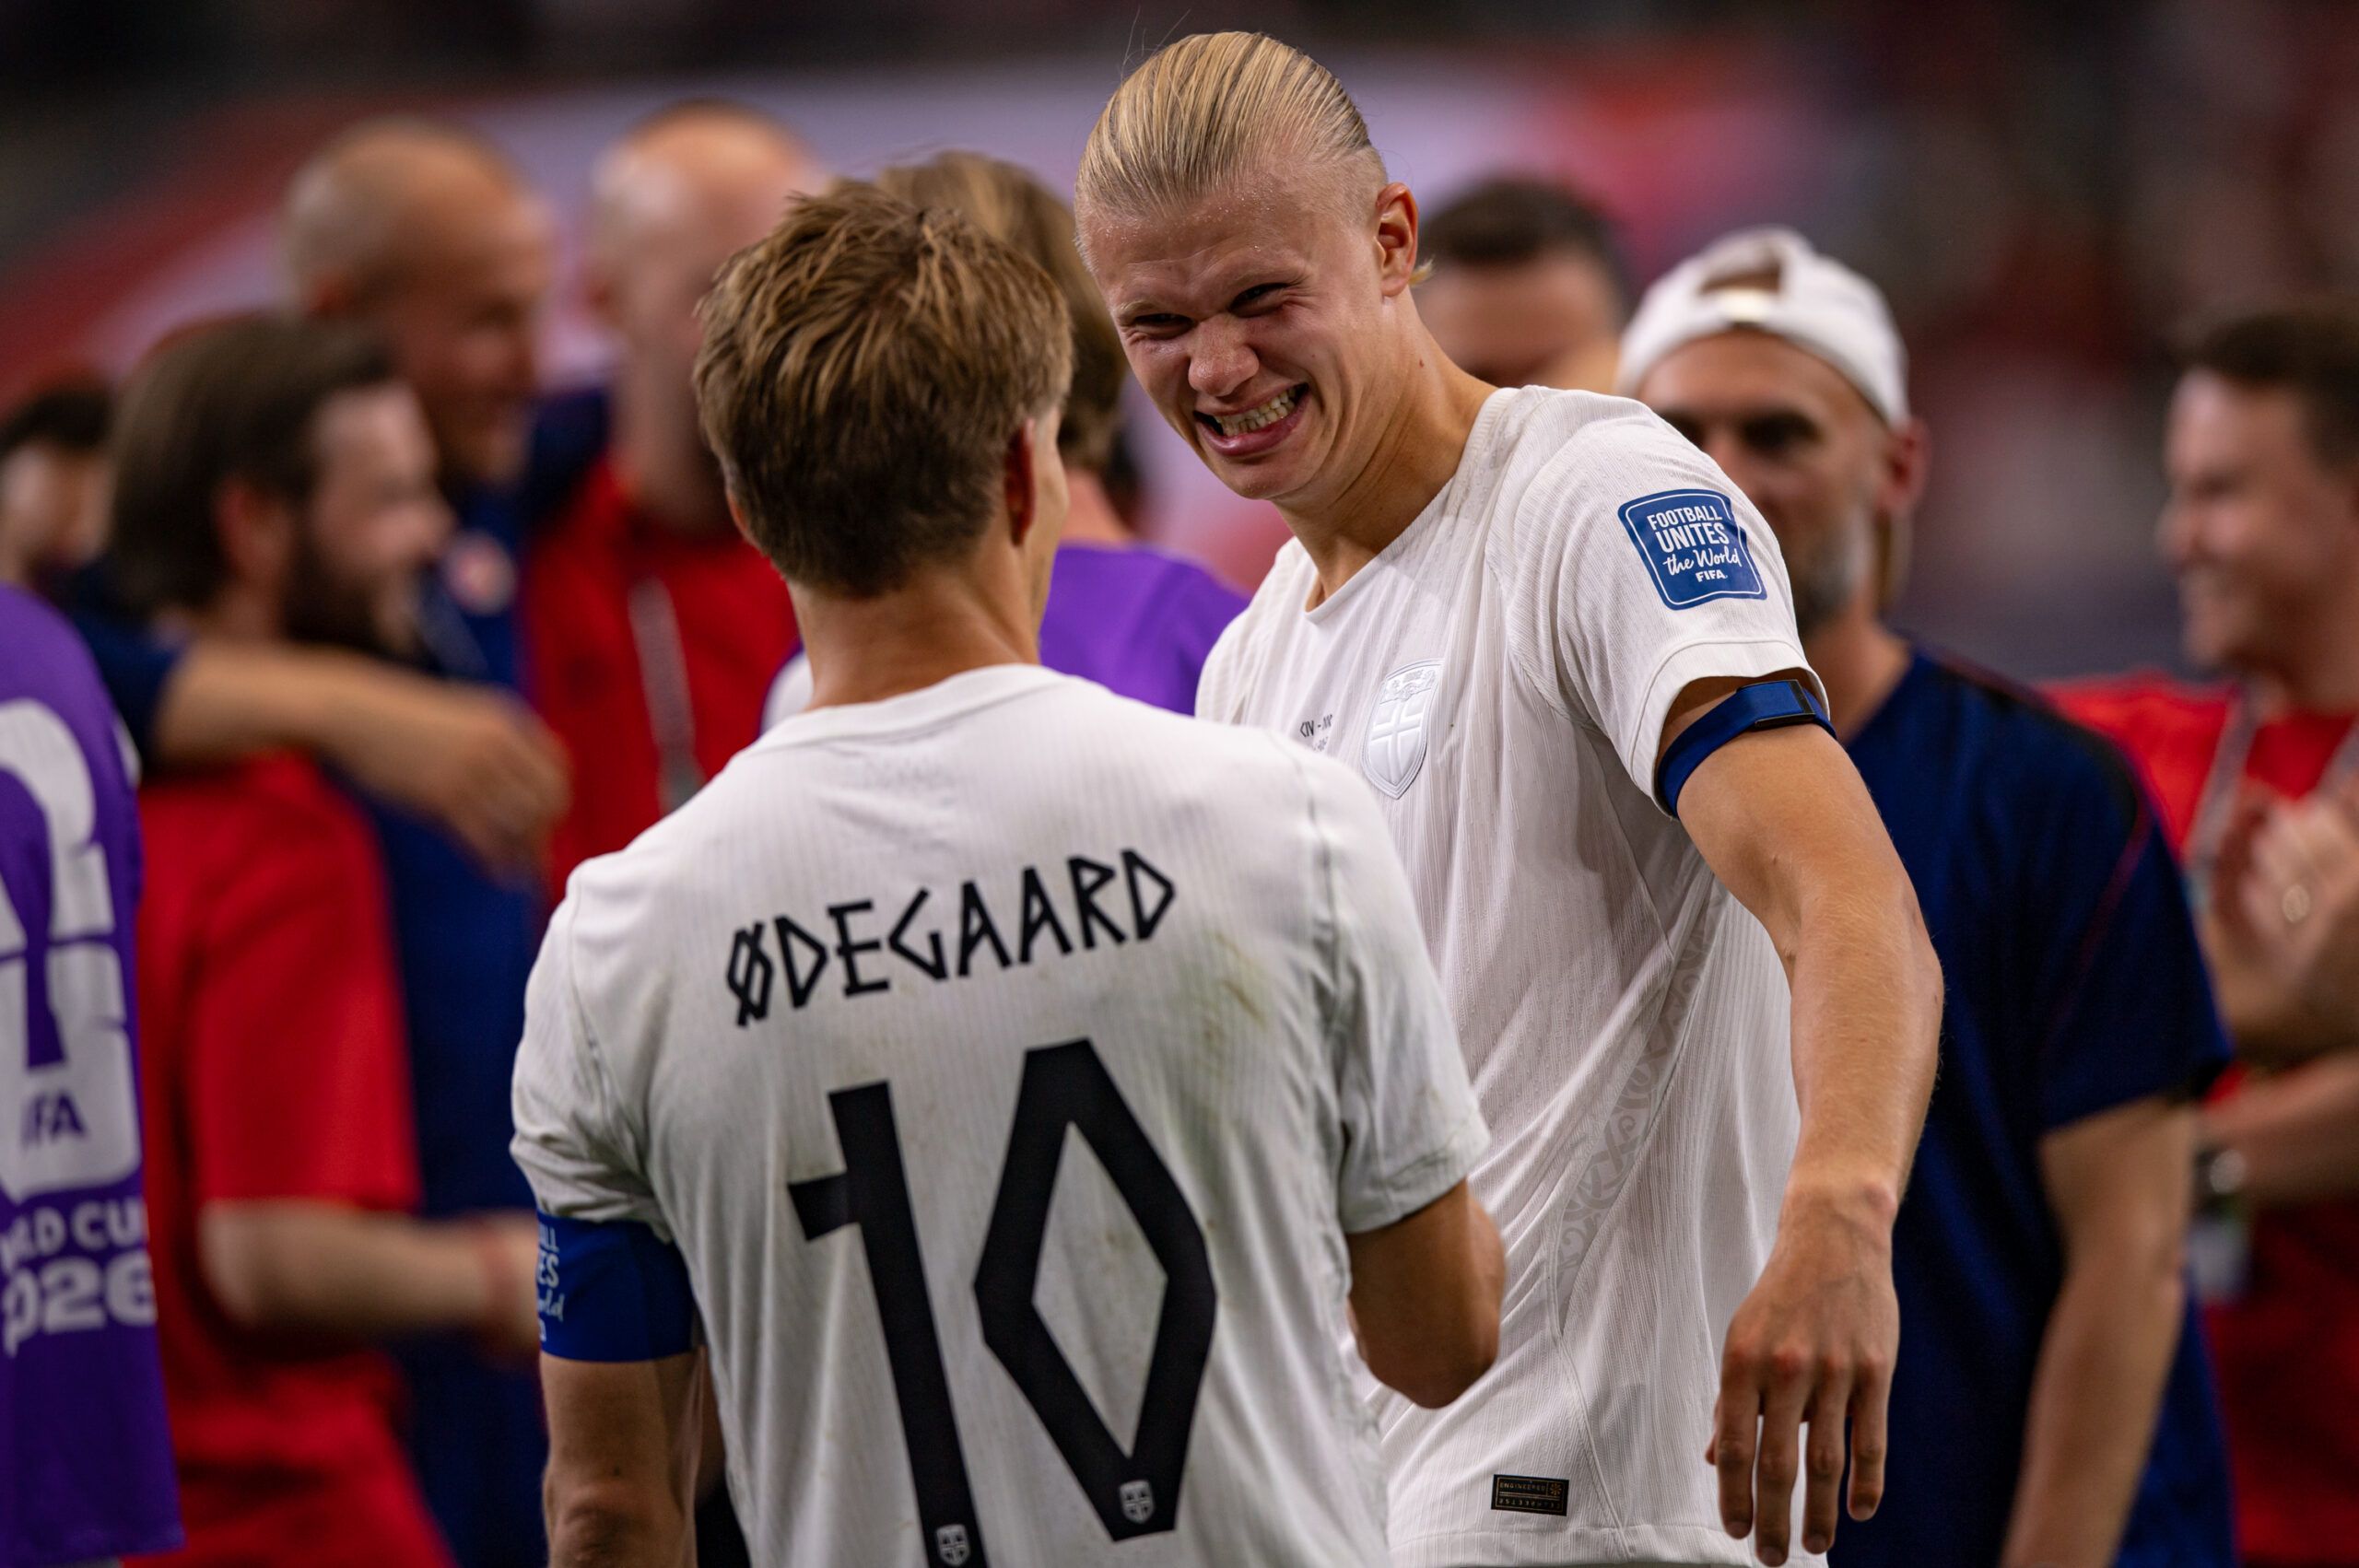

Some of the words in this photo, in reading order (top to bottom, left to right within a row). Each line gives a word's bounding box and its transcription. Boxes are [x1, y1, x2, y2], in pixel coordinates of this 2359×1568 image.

[1648, 507, 1722, 530] FOOTBALL
[1655, 522, 1730, 553] UNITES
[1662, 554, 1695, 576] the
[1693, 545, 1743, 568] World
[1695, 569, 1727, 582] FIFA
[725, 848, 1177, 1028] ØDEGAARD
[70, 1197, 150, 1252] CU
[3, 1247, 158, 1359] 026
[787, 1036, 1216, 1568] 10
